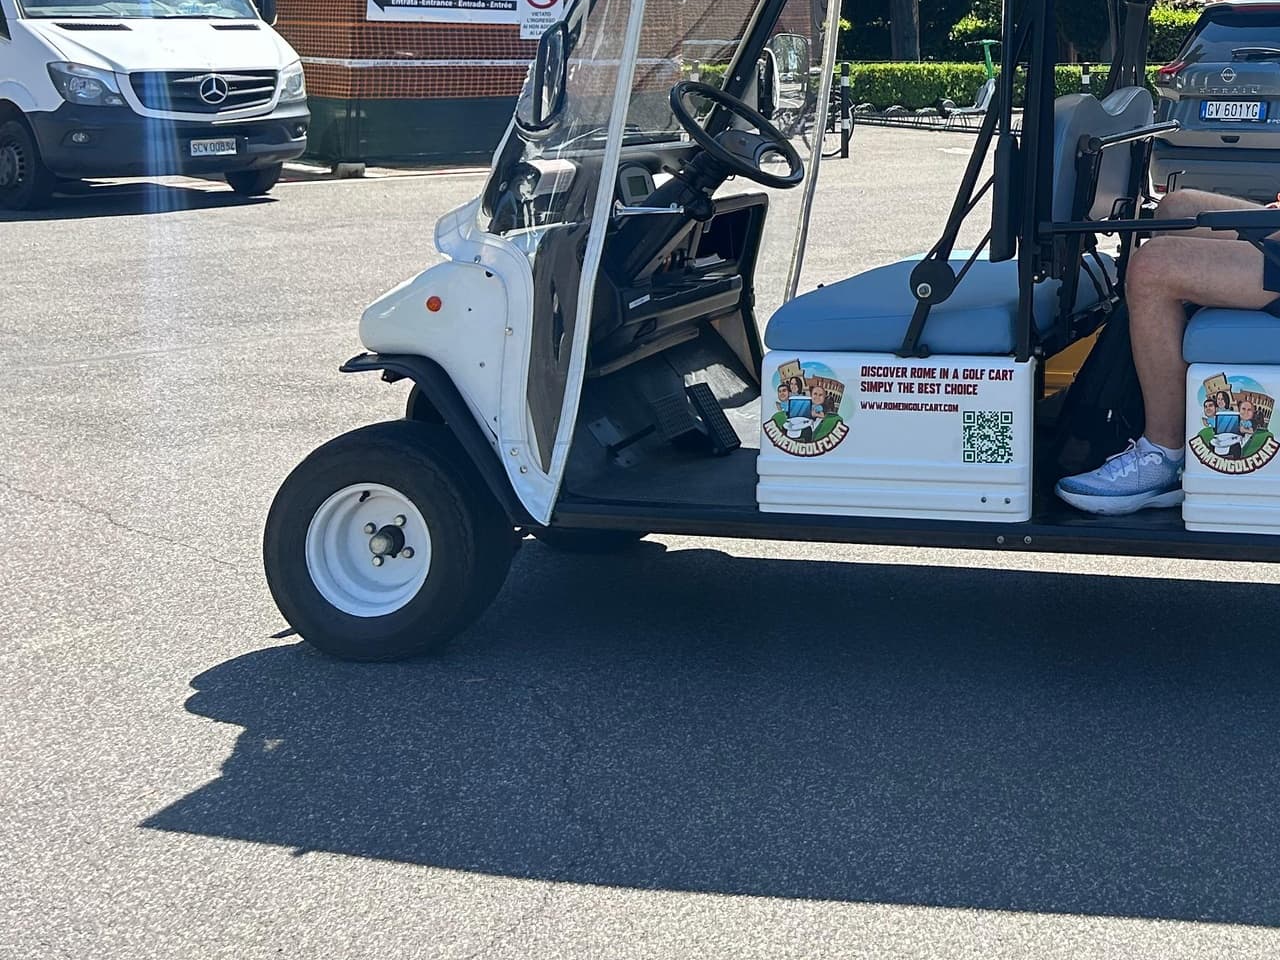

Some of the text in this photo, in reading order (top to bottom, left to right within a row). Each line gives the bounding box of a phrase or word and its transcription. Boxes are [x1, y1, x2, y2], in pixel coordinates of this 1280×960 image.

[458, 0, 486, 8] Entrada
[861, 366, 1014, 381] DISCOVER ROME IN A GOLF CART
[861, 381, 978, 396] SIMPLY THE BEST CHOICE
[860, 401, 959, 413] WWW.ROMEINGOLFCART.COM
[764, 421, 849, 457] ROMEINGOLFCART
[1190, 437, 1279, 473] ROMEINGOLFCART
